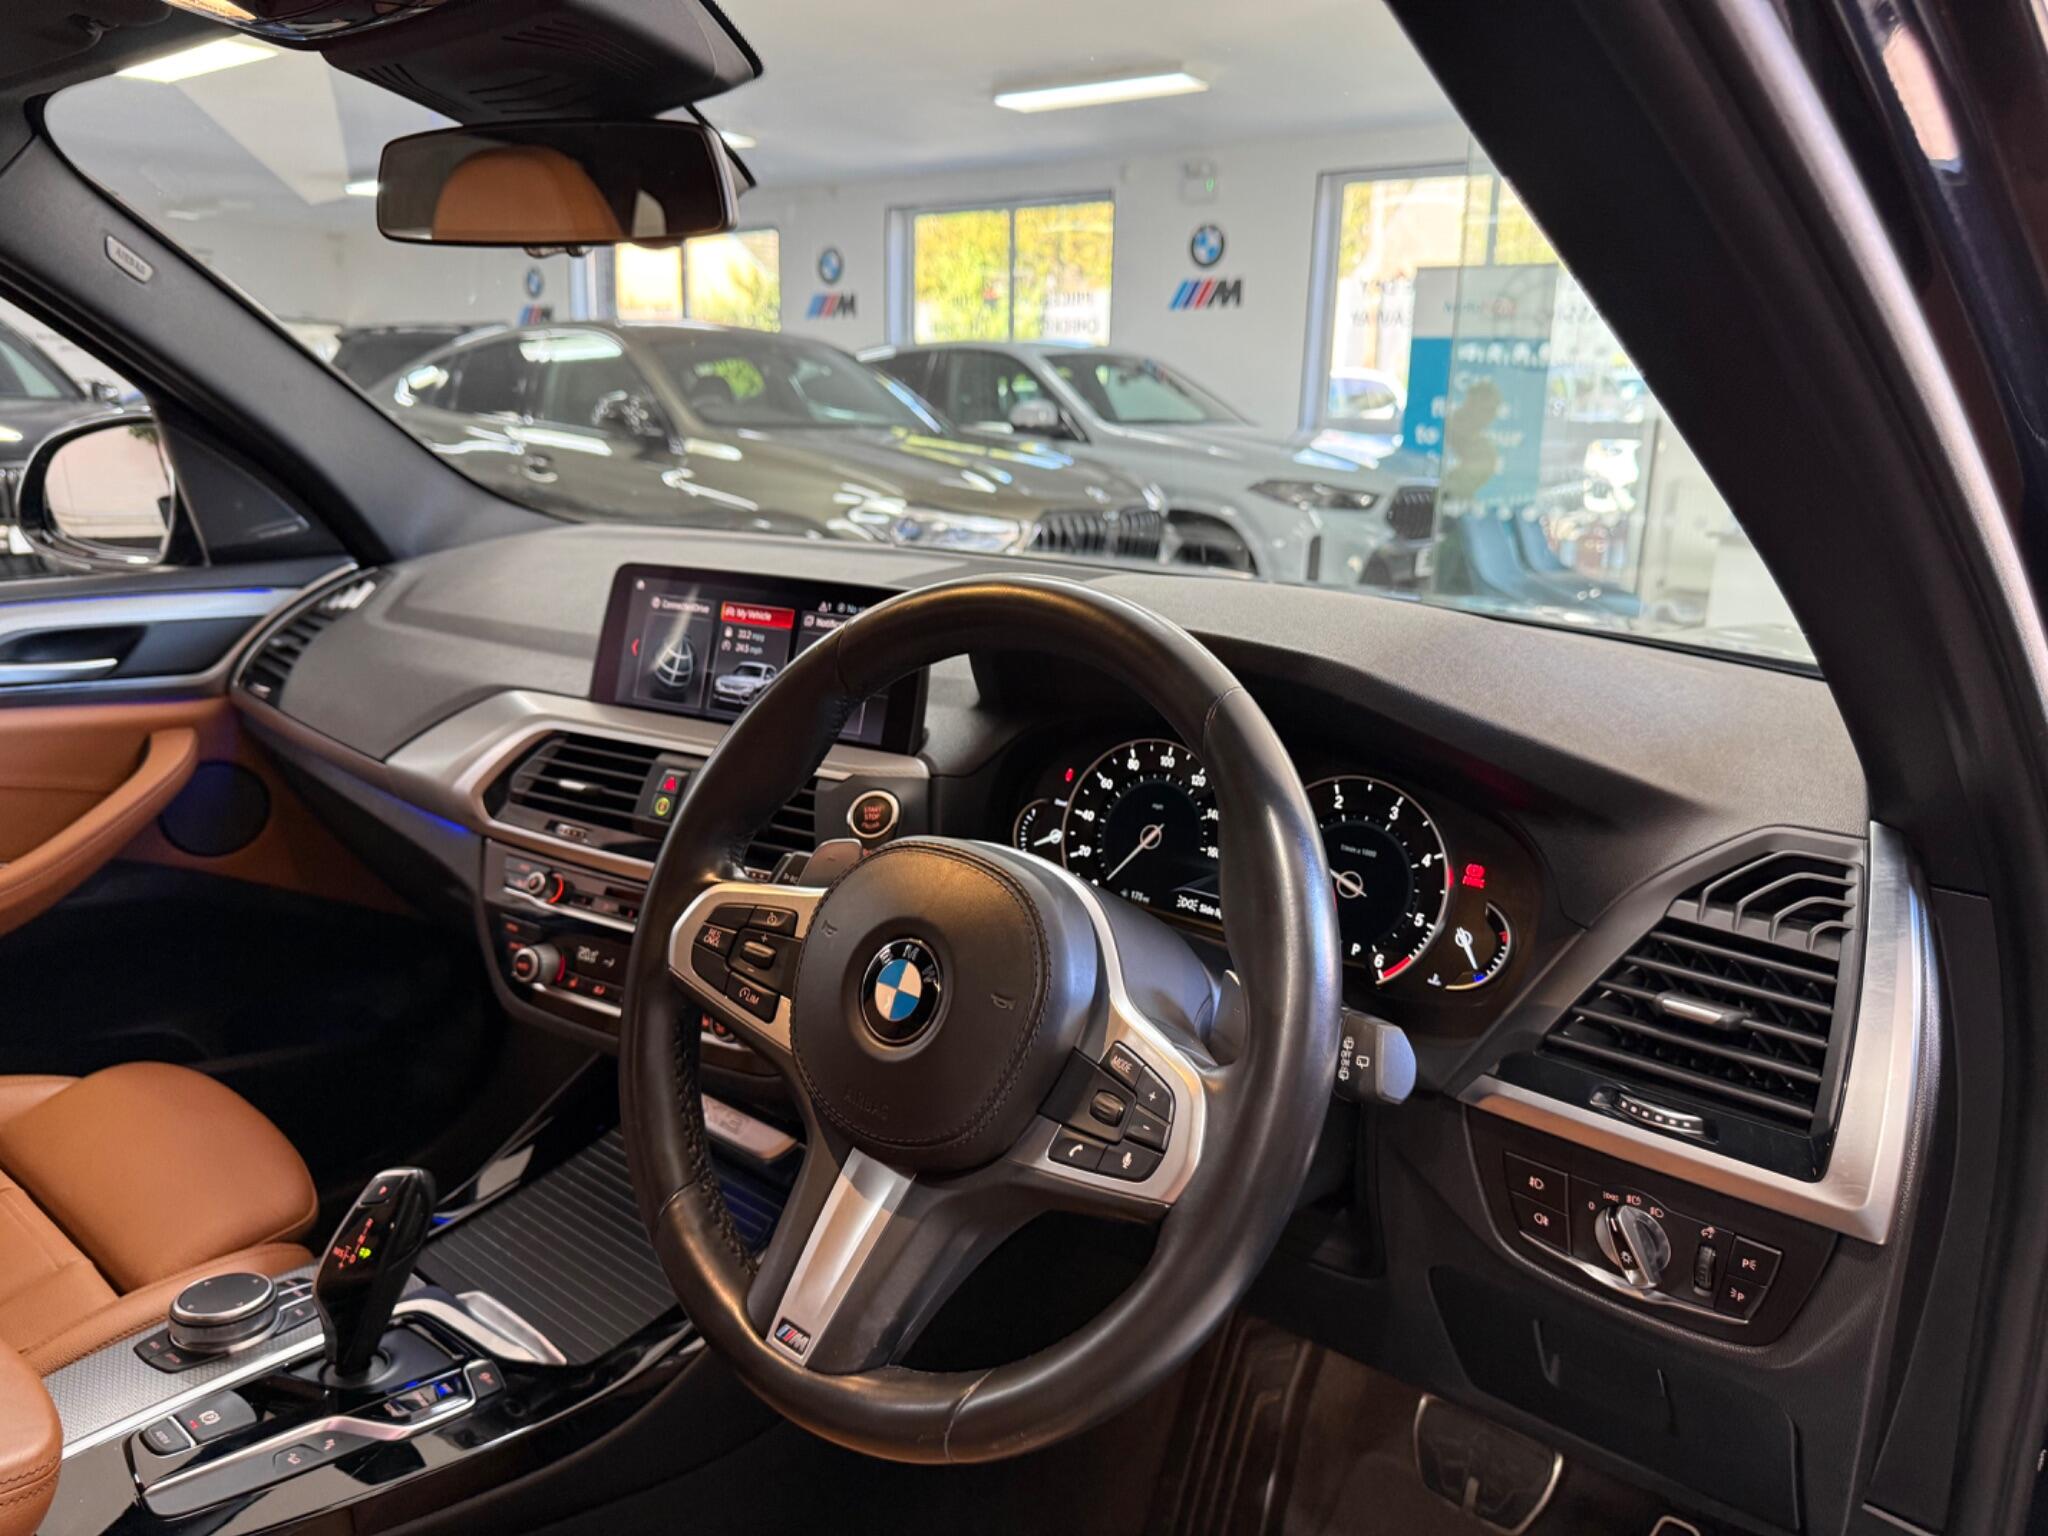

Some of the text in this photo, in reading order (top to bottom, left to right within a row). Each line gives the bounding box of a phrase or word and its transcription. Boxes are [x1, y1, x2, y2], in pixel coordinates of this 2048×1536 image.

[1127, 758, 1141, 772] 80
[1160, 755, 1175, 769] 100
[1100, 778, 1114, 790] 60
[1191, 774, 1206, 788] 120
[1333, 794, 1344, 809] 2
[1081, 809, 1095, 822] 40
[1389, 805, 1400, 820] 3
[1078, 843, 1092, 857] 20
[1421, 853, 1432, 868] 4
[1413, 912, 1425, 927] 5
[1351, 943, 1362, 956] P
[880, 944, 936, 983] BMW
[1373, 954, 1385, 968] 6
